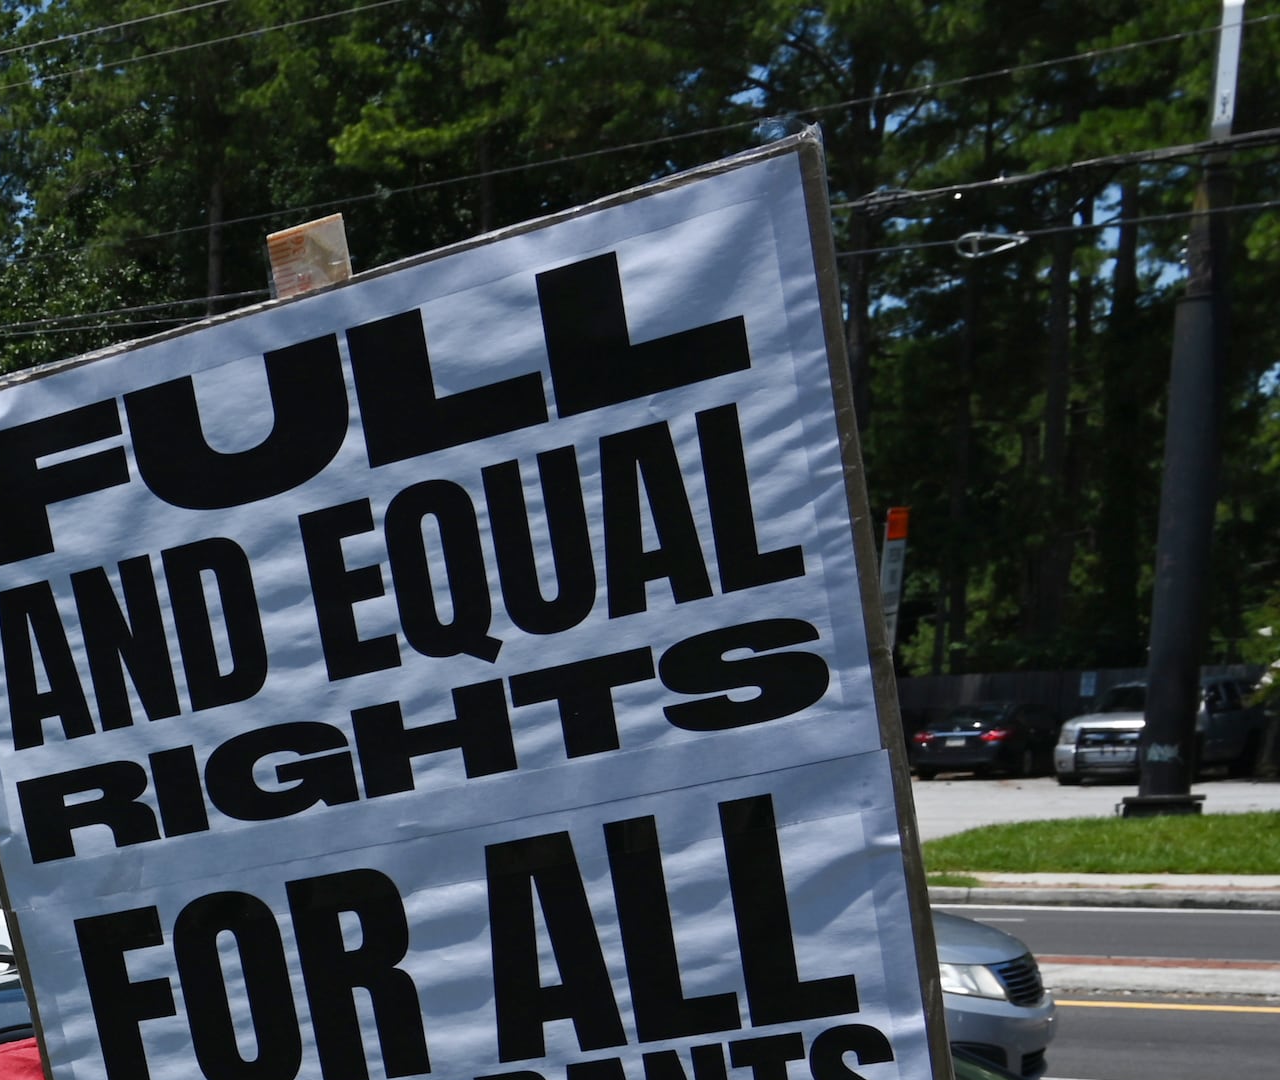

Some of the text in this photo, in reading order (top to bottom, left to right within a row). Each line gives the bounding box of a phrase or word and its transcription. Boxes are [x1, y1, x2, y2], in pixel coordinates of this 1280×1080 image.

[297, 402, 807, 684] EQUAL
[15, 616, 831, 864] RIGHTS
[483, 793, 859, 1065] ALL
